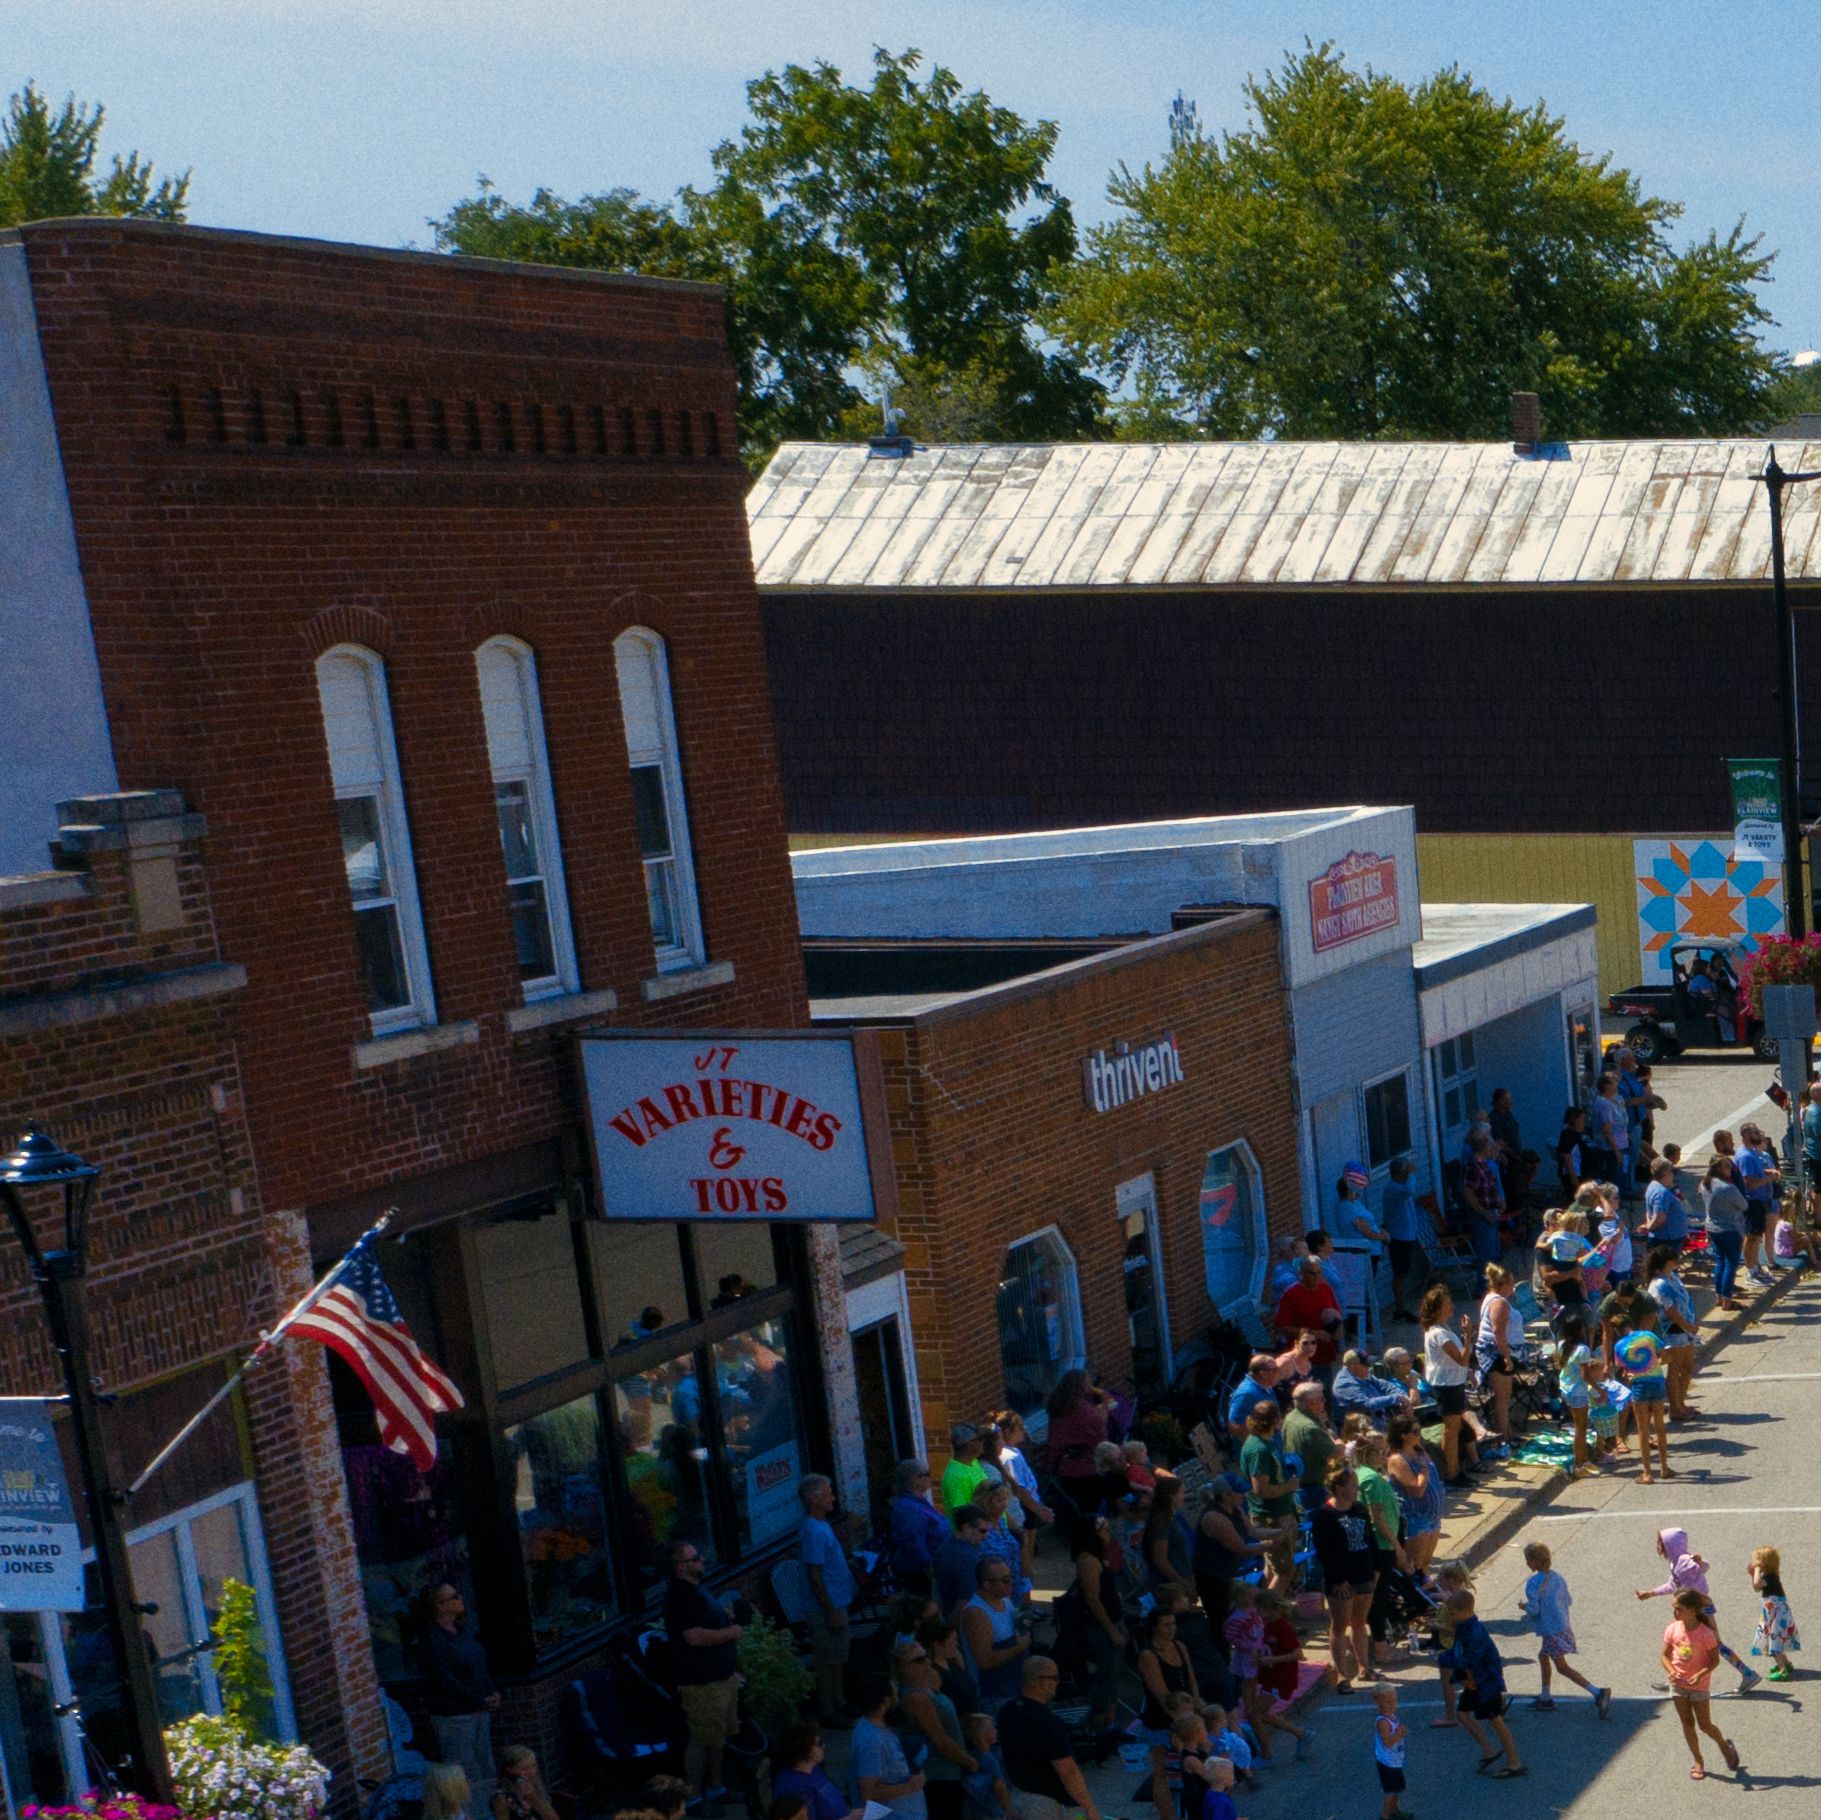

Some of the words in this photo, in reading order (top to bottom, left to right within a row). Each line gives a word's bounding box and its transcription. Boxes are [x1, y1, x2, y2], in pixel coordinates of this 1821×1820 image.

[1737, 807, 1777, 815] PLAINVIEW
[694, 1047, 739, 1072] JT
[1090, 1031, 1184, 1113] thrivent
[608, 1078, 842, 1152] VARIETIES
[709, 1126, 746, 1170] &
[690, 1177, 788, 1213] TOYS
[4, 1561, 55, 1574] JONES
